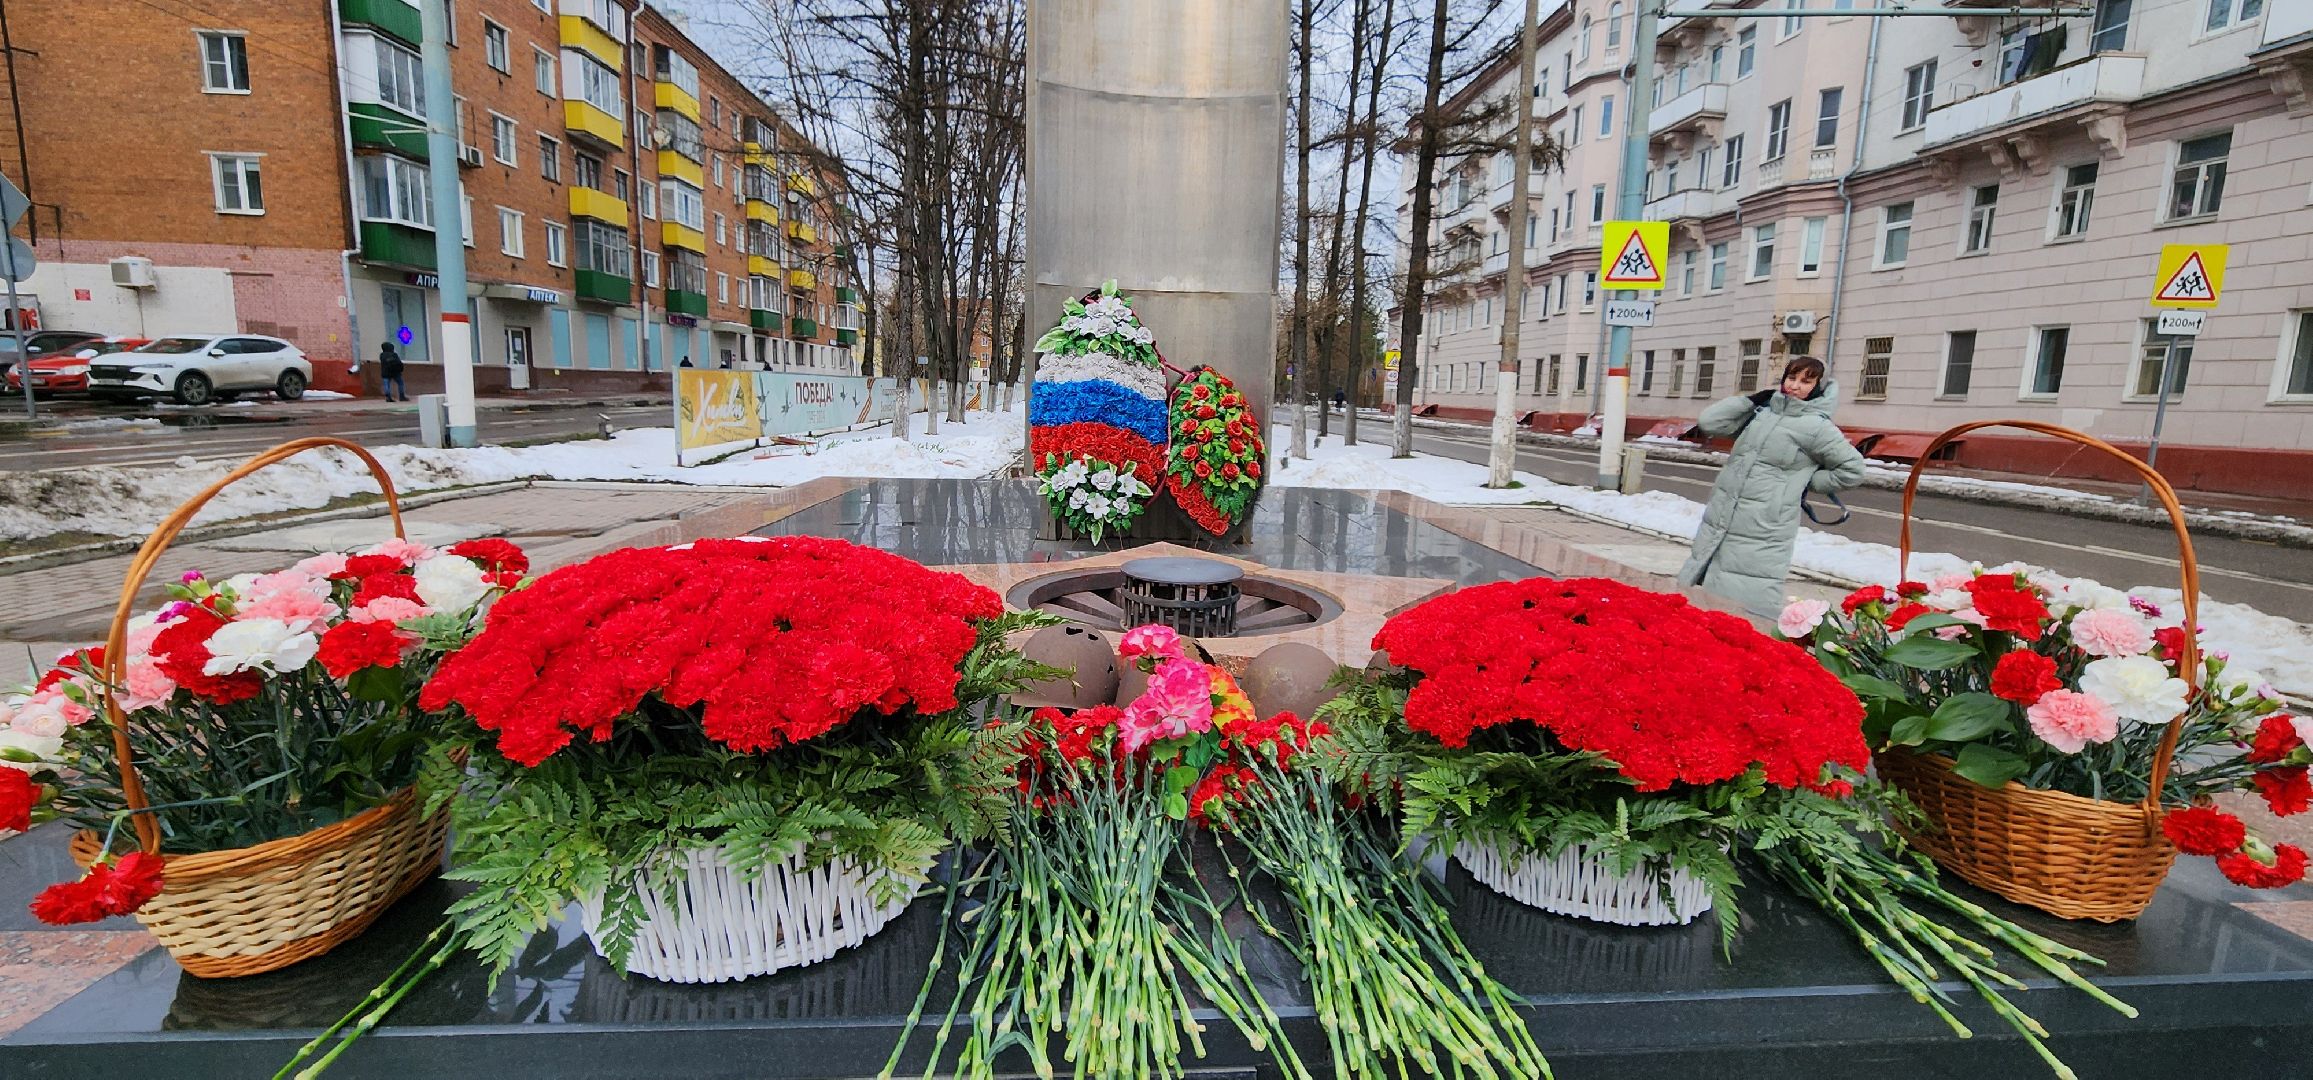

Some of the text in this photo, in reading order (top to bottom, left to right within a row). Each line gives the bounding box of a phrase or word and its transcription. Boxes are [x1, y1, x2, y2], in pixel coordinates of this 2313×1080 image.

[530, 290, 560, 304] АПТЕКА
[2168, 318, 2195, 328] 200м
[795, 382, 834, 408] ПОБЕДА!
